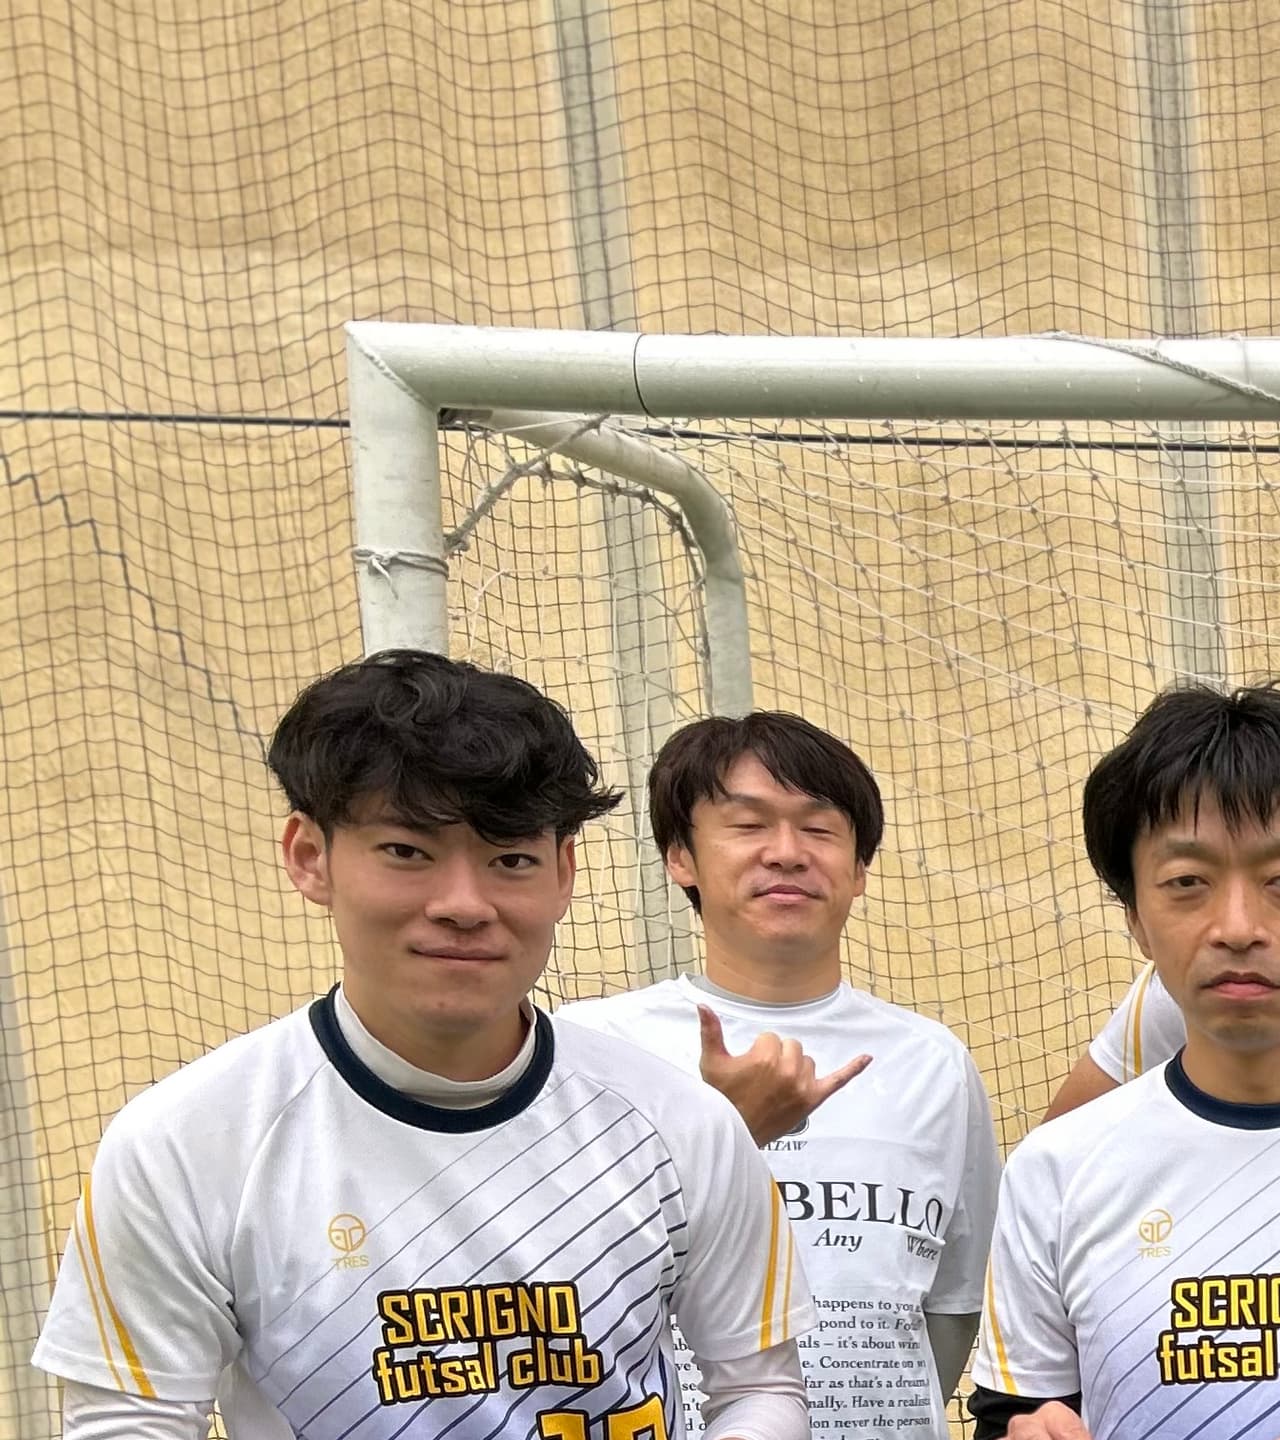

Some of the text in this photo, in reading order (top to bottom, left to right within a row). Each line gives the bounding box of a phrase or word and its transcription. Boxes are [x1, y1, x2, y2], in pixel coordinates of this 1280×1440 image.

[812, 1227, 863, 1252] Any
[331, 1254, 370, 1270] TRES
[812, 1295, 874, 1312] happens
[877, 1299, 892, 1311] to
[378, 1282, 582, 1346] SCRIGNO
[860, 1319, 874, 1329] to
[861, 1336, 895, 1349] about
[820, 1355, 900, 1369] Concentrate
[1157, 1327, 1279, 1385] futsal
[374, 1335, 604, 1405] futsal club
[804, 1375, 824, 1388] far
[828, 1380, 844, 1388] as
[848, 1375, 882, 1388] that's
[886, 1380, 893, 1388] a
[852, 1395, 884, 1408] Have
[888, 1400, 895, 1408] a
[834, 1419, 870, 1428] never
[872, 1414, 895, 1427] the
